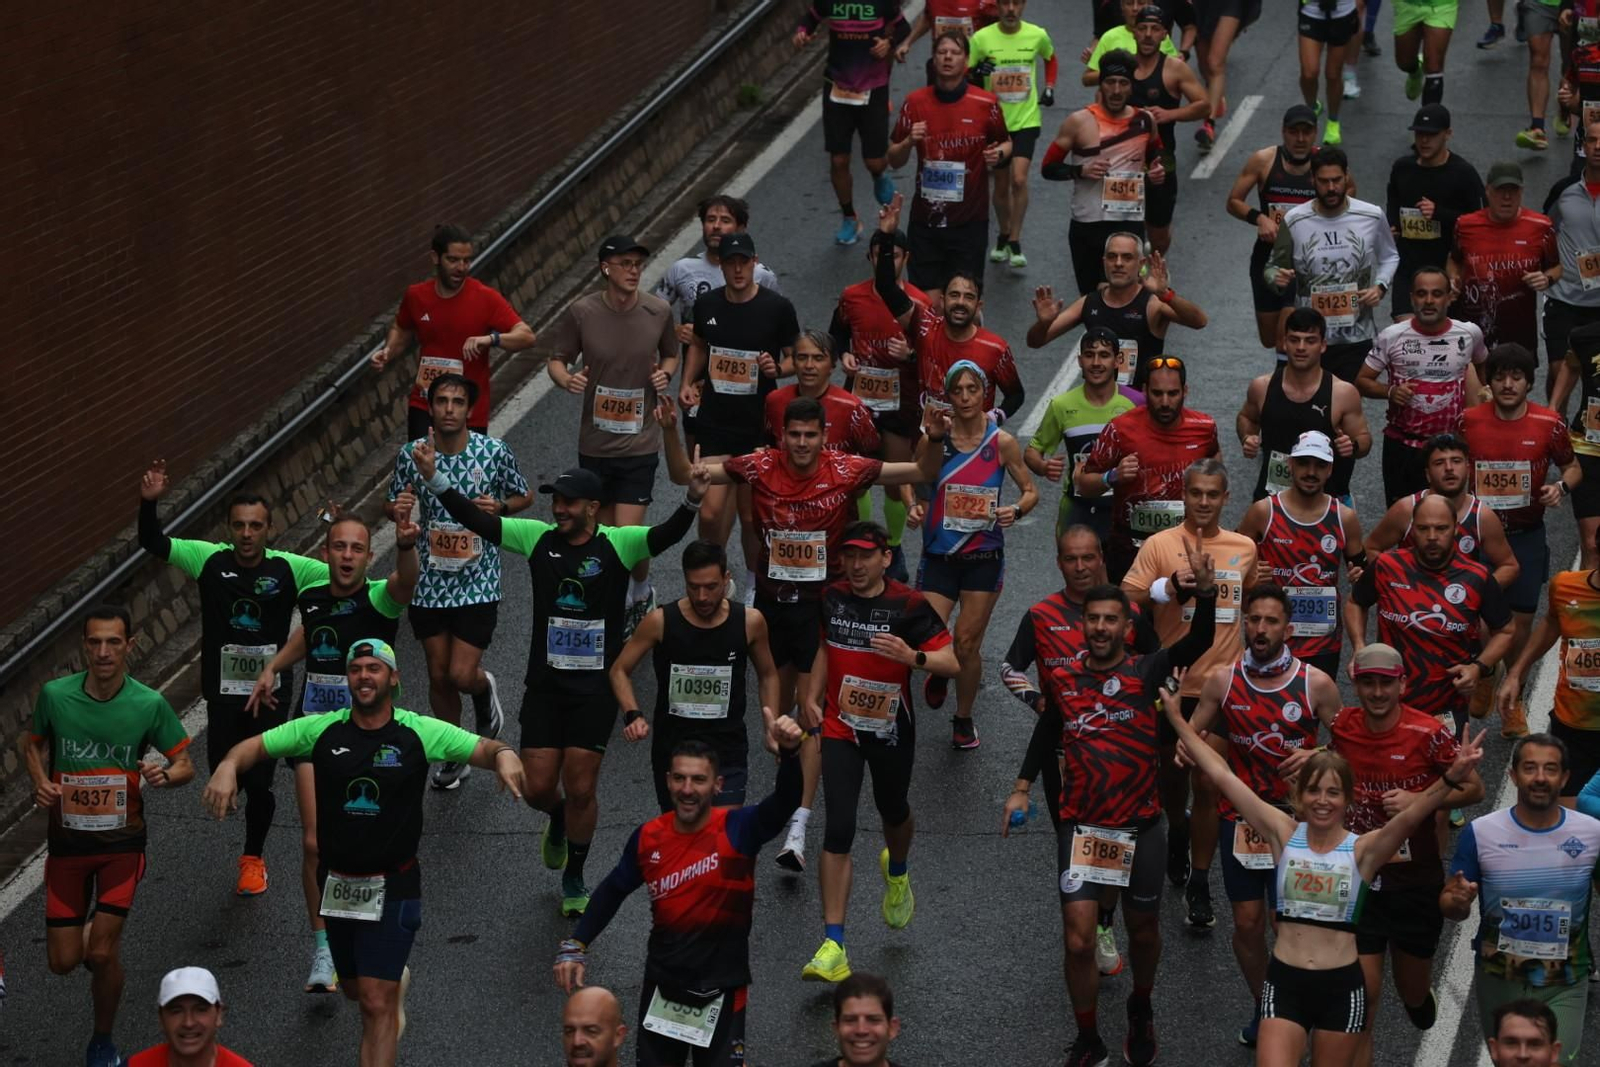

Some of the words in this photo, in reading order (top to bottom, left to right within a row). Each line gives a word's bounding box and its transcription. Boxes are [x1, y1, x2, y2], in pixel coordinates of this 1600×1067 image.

[996, 75, 1023, 87] 4475
[926, 170, 955, 184] 2540
[1110, 181, 1136, 194] 4314
[1324, 231, 1342, 247] XL
[1585, 257, 1600, 271] 61
[1318, 295, 1348, 309] 5123
[716, 359, 746, 375] 4783
[860, 377, 889, 393] 5073
[602, 399, 632, 414] 4784
[1483, 473, 1518, 488] 4354
[953, 496, 986, 512] 3722
[1138, 512, 1171, 526] 8103
[436, 534, 469, 551] 4373
[778, 542, 813, 559] 5010
[1291, 598, 1325, 615] 2593
[830, 616, 850, 628] SAN
[851, 622, 891, 633] PABLO
[555, 630, 591, 648] 2154
[230, 657, 265, 673] 7001
[1574, 652, 1600, 668] 466
[675, 677, 721, 695] 10396
[309, 686, 347, 704] 2305
[71, 789, 111, 806] 4337
[1082, 840, 1119, 860] 5188
[1294, 872, 1334, 895] 7251
[333, 882, 373, 903] 6840
[1510, 913, 1554, 932] 3015
